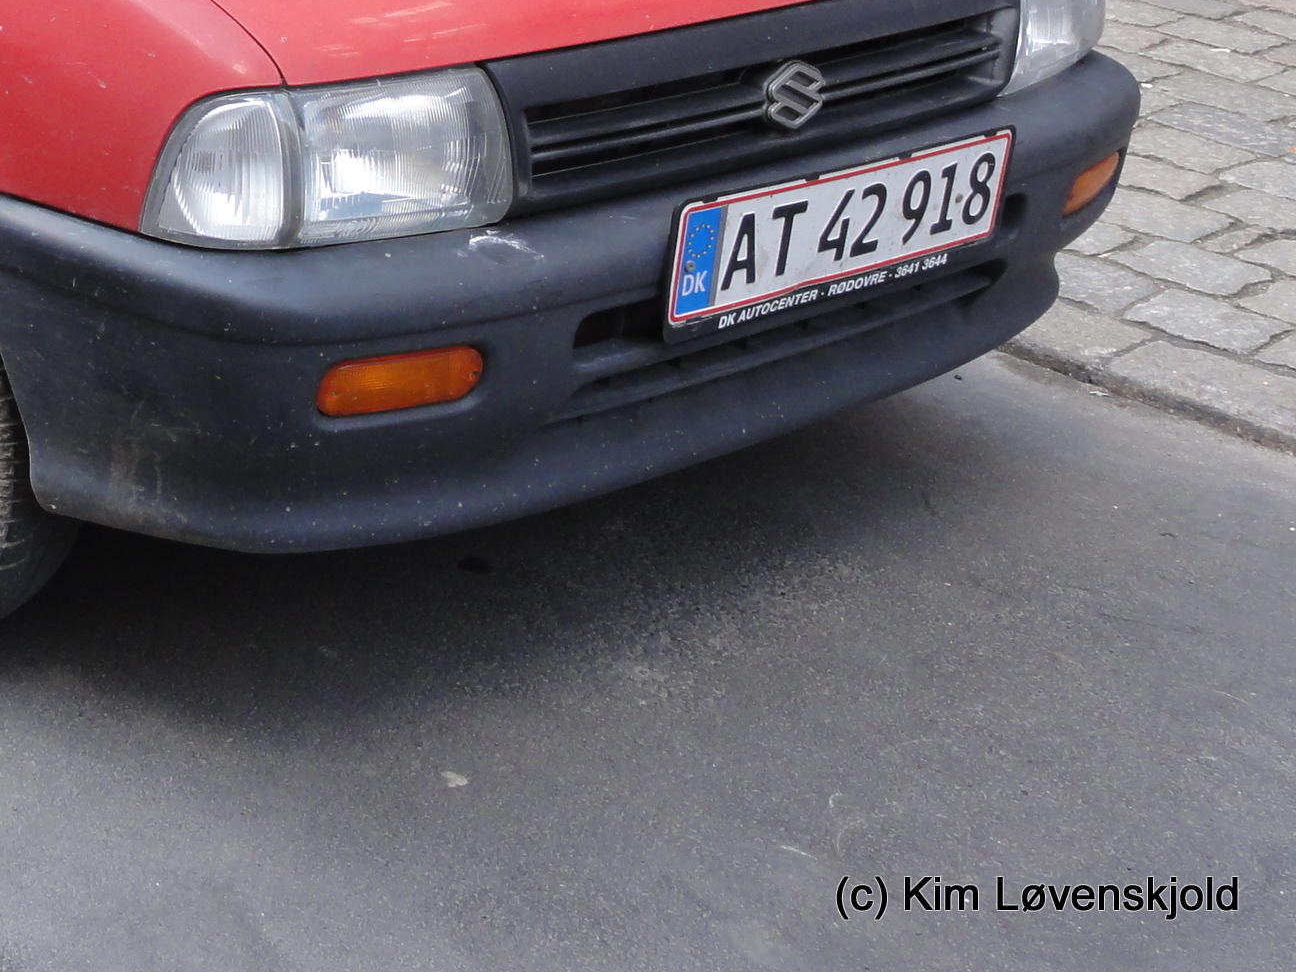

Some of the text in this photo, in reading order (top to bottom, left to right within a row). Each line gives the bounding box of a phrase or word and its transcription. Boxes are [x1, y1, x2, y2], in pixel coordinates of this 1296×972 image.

[720, 151, 996, 291] AT 42 918
[681, 270, 708, 297] DK
[717, 252, 948, 329] DK AUTOCENTER RØDOVRE 3641 3644
